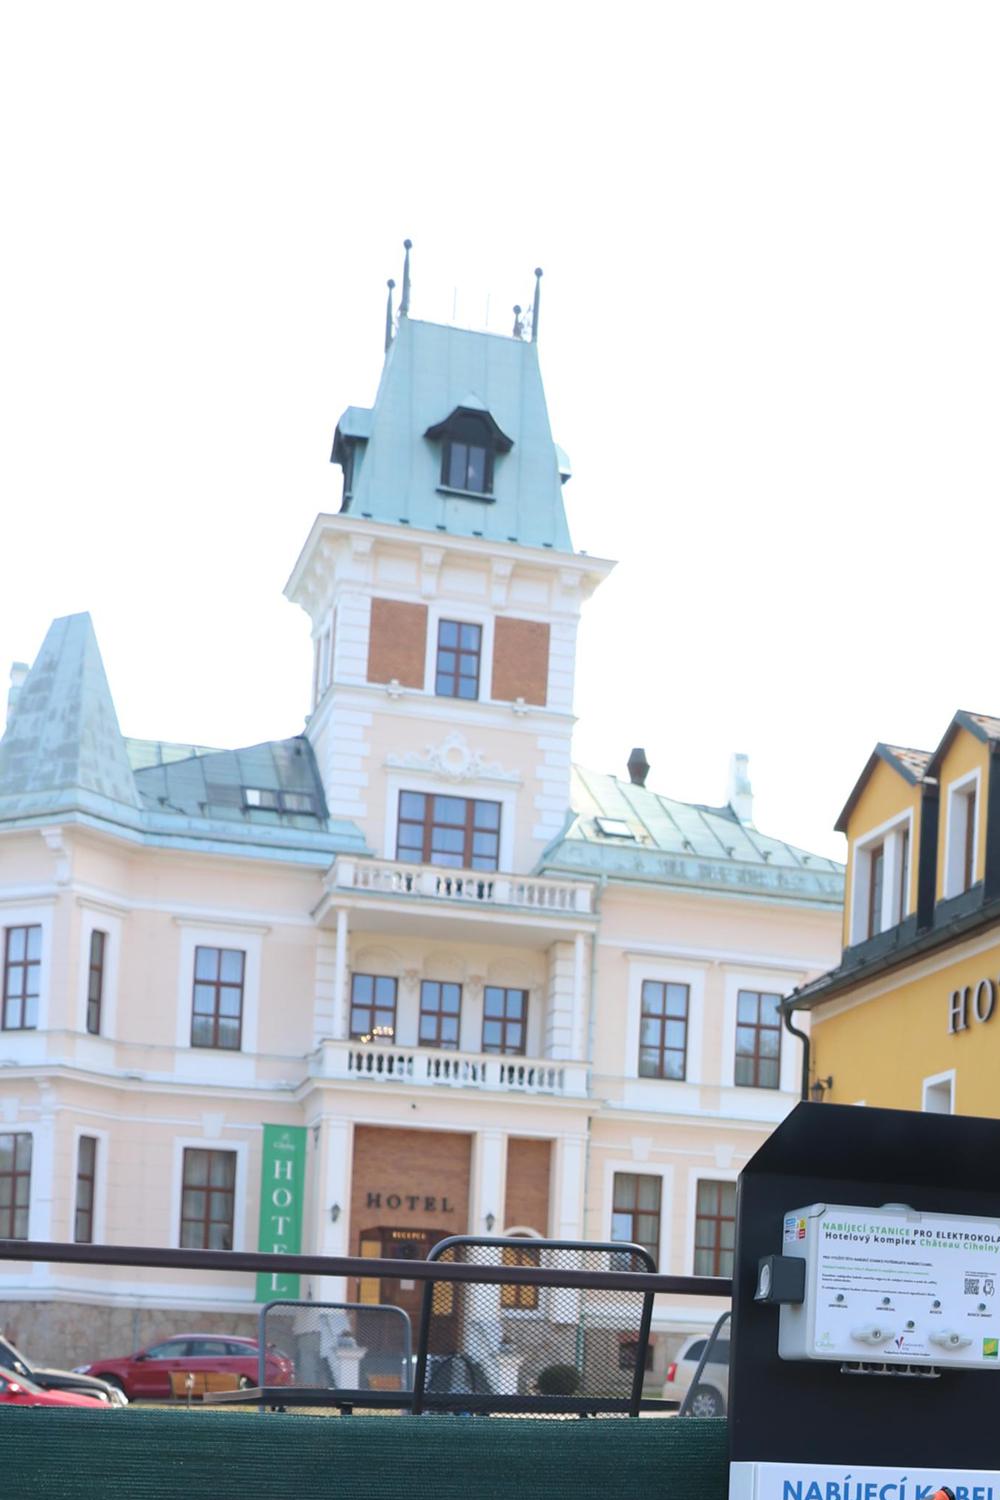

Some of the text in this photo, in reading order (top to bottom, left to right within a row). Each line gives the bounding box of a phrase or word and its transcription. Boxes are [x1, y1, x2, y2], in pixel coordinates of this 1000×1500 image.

[366, 1191, 454, 1213] HOTEL
[822, 1221, 867, 1236] NABÍJECÍ
[869, 1224, 911, 1236] STANICE
[913, 1229, 933, 1238] PRO
[825, 1232, 870, 1245] Hotelový
[873, 1234, 916, 1246] komplex
